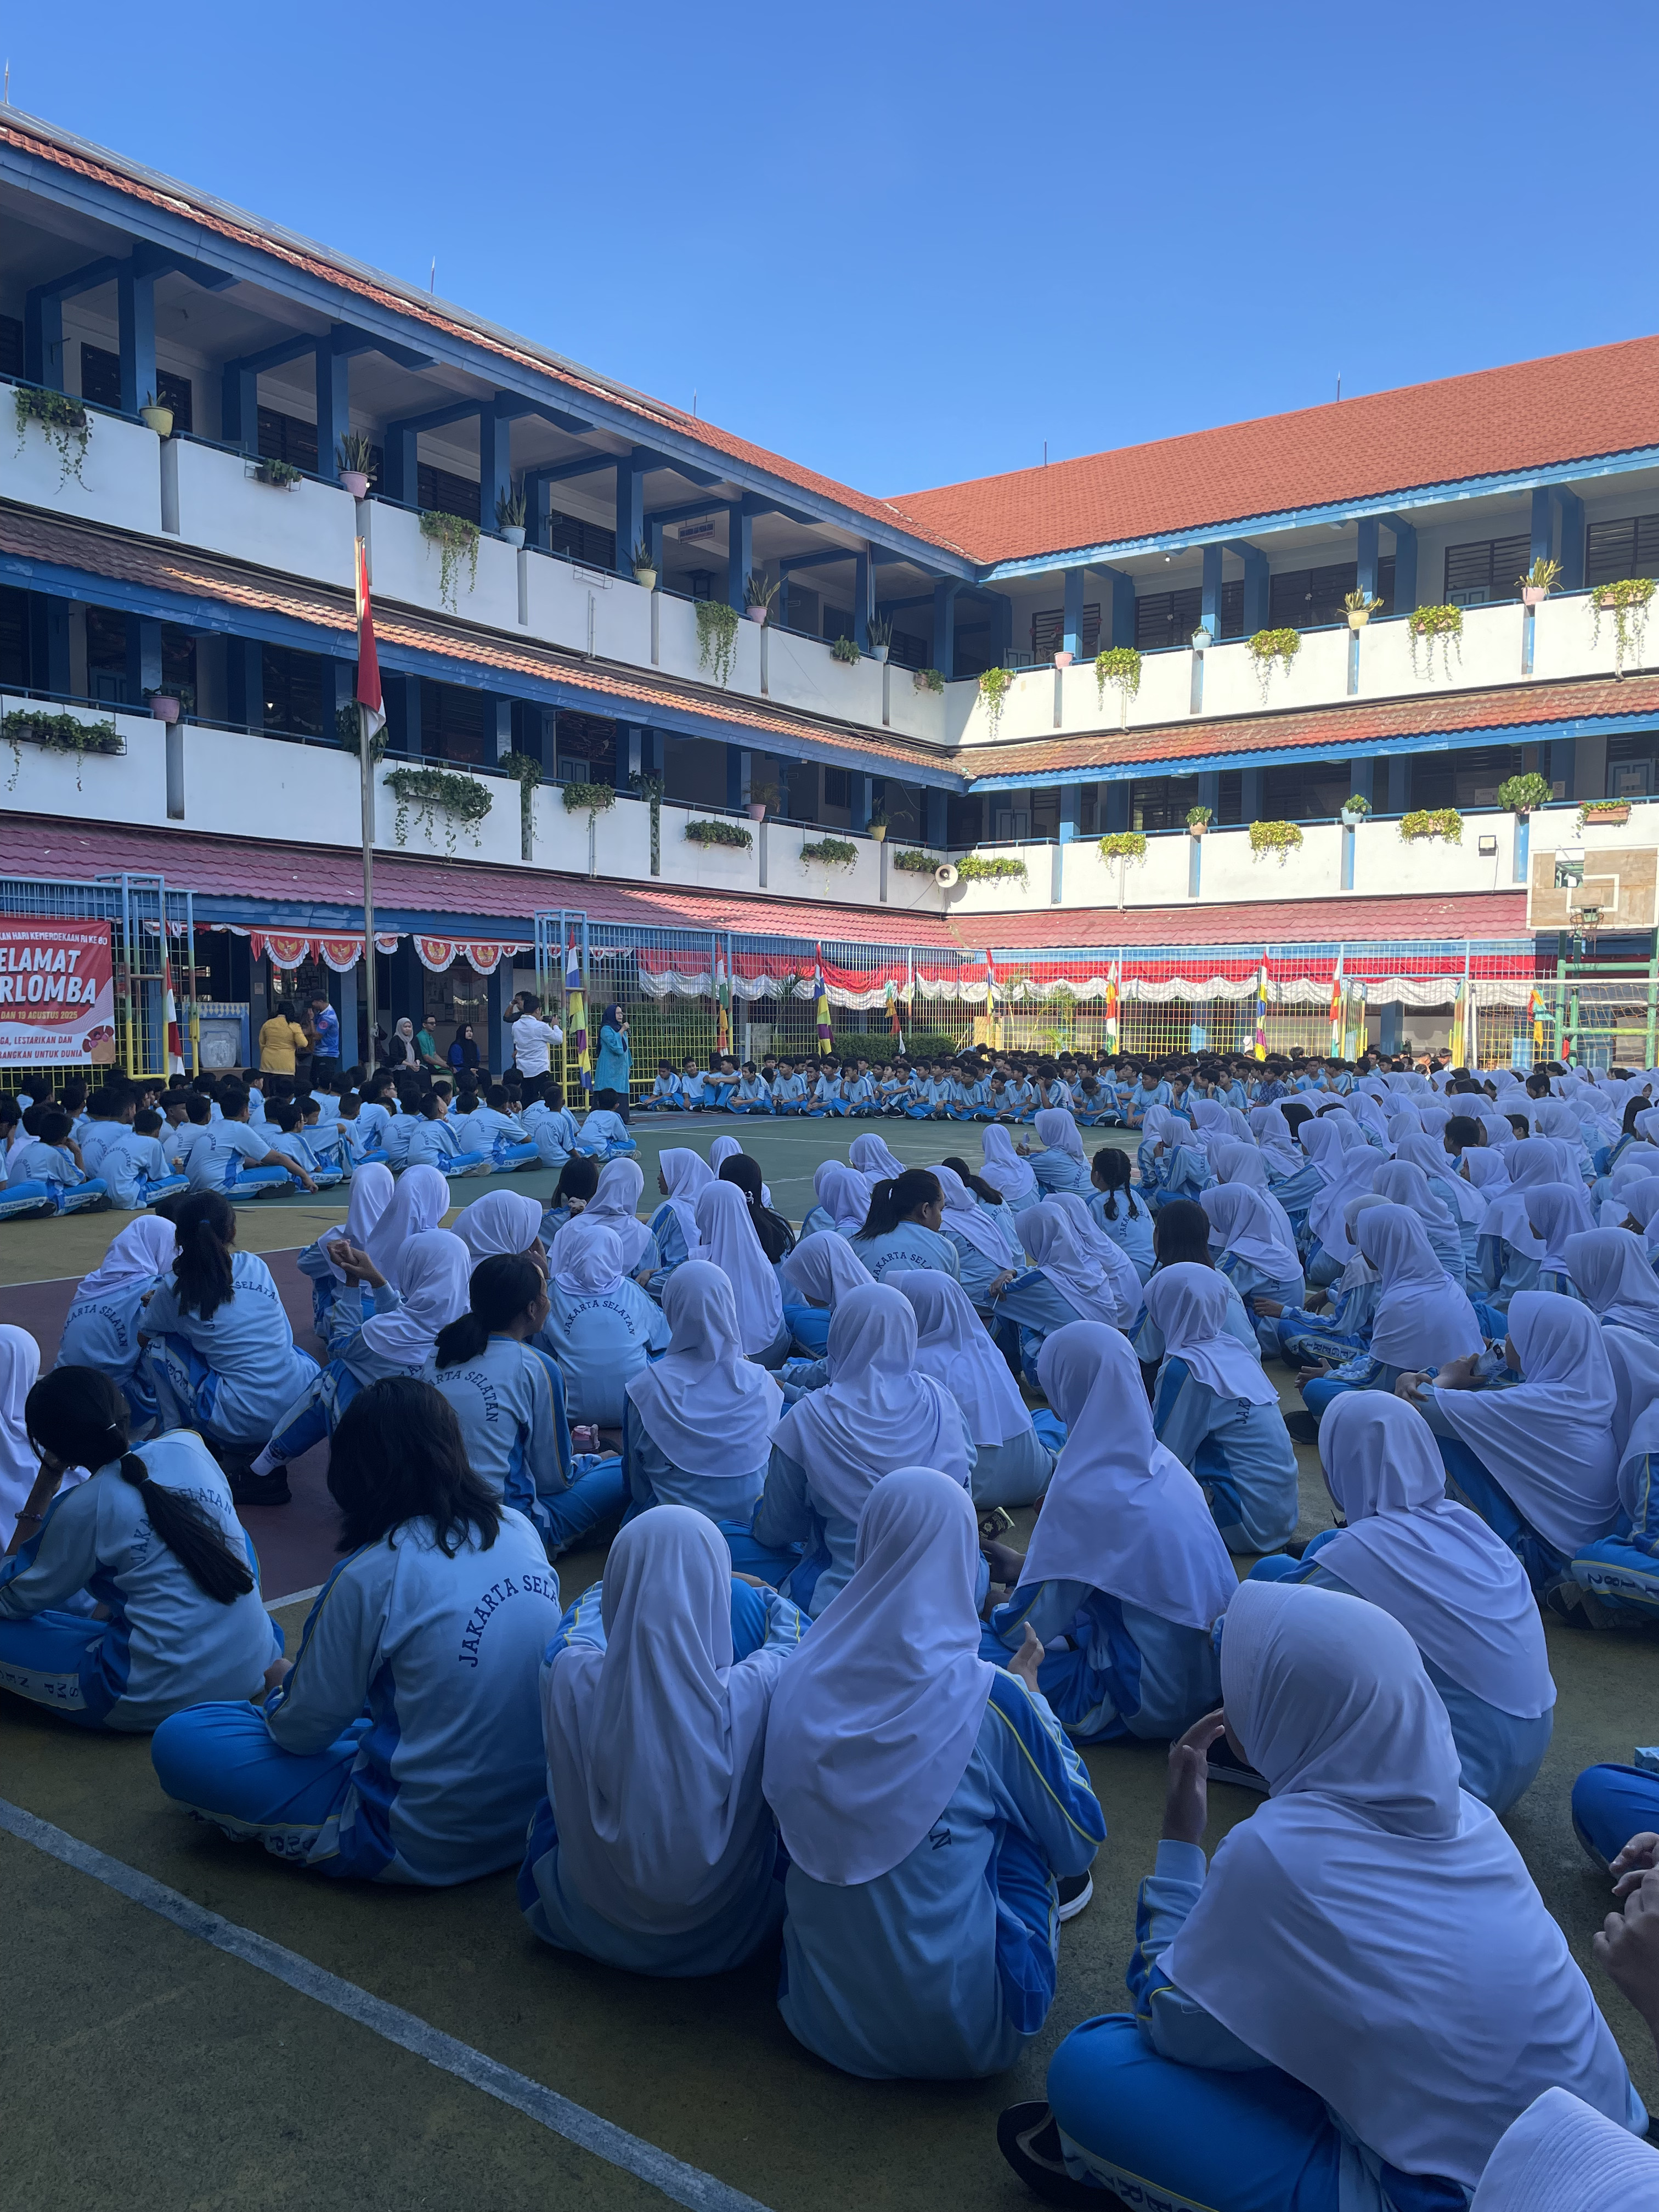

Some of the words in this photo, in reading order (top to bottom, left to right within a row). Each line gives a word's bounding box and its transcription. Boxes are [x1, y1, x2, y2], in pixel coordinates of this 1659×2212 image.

[30, 932, 79, 943] KEMERDEKAAN
[0, 947, 81, 973] ELAMAT
[0, 975, 95, 1004] RLOMBA
[14, 1036, 57, 1045] LESTARIKAN
[35, 1050, 59, 1058] UNTUK
[61, 1049, 82, 1058] DUNIA
[872, 1251, 907, 1282] JAKARTA
[910, 1254, 933, 1269] SELA
[99, 1306, 128, 1347] SELATAN
[564, 1300, 599, 1335] JAKARTA
[602, 1300, 635, 1335] SELATAN
[465, 1372, 499, 1423] SELATAN
[131, 1518, 154, 1562] JAKA
[458, 1578, 519, 1668] JAKARTA
[522, 1575, 558, 1608] SELA
[44, 1682, 79, 1700] SMP
